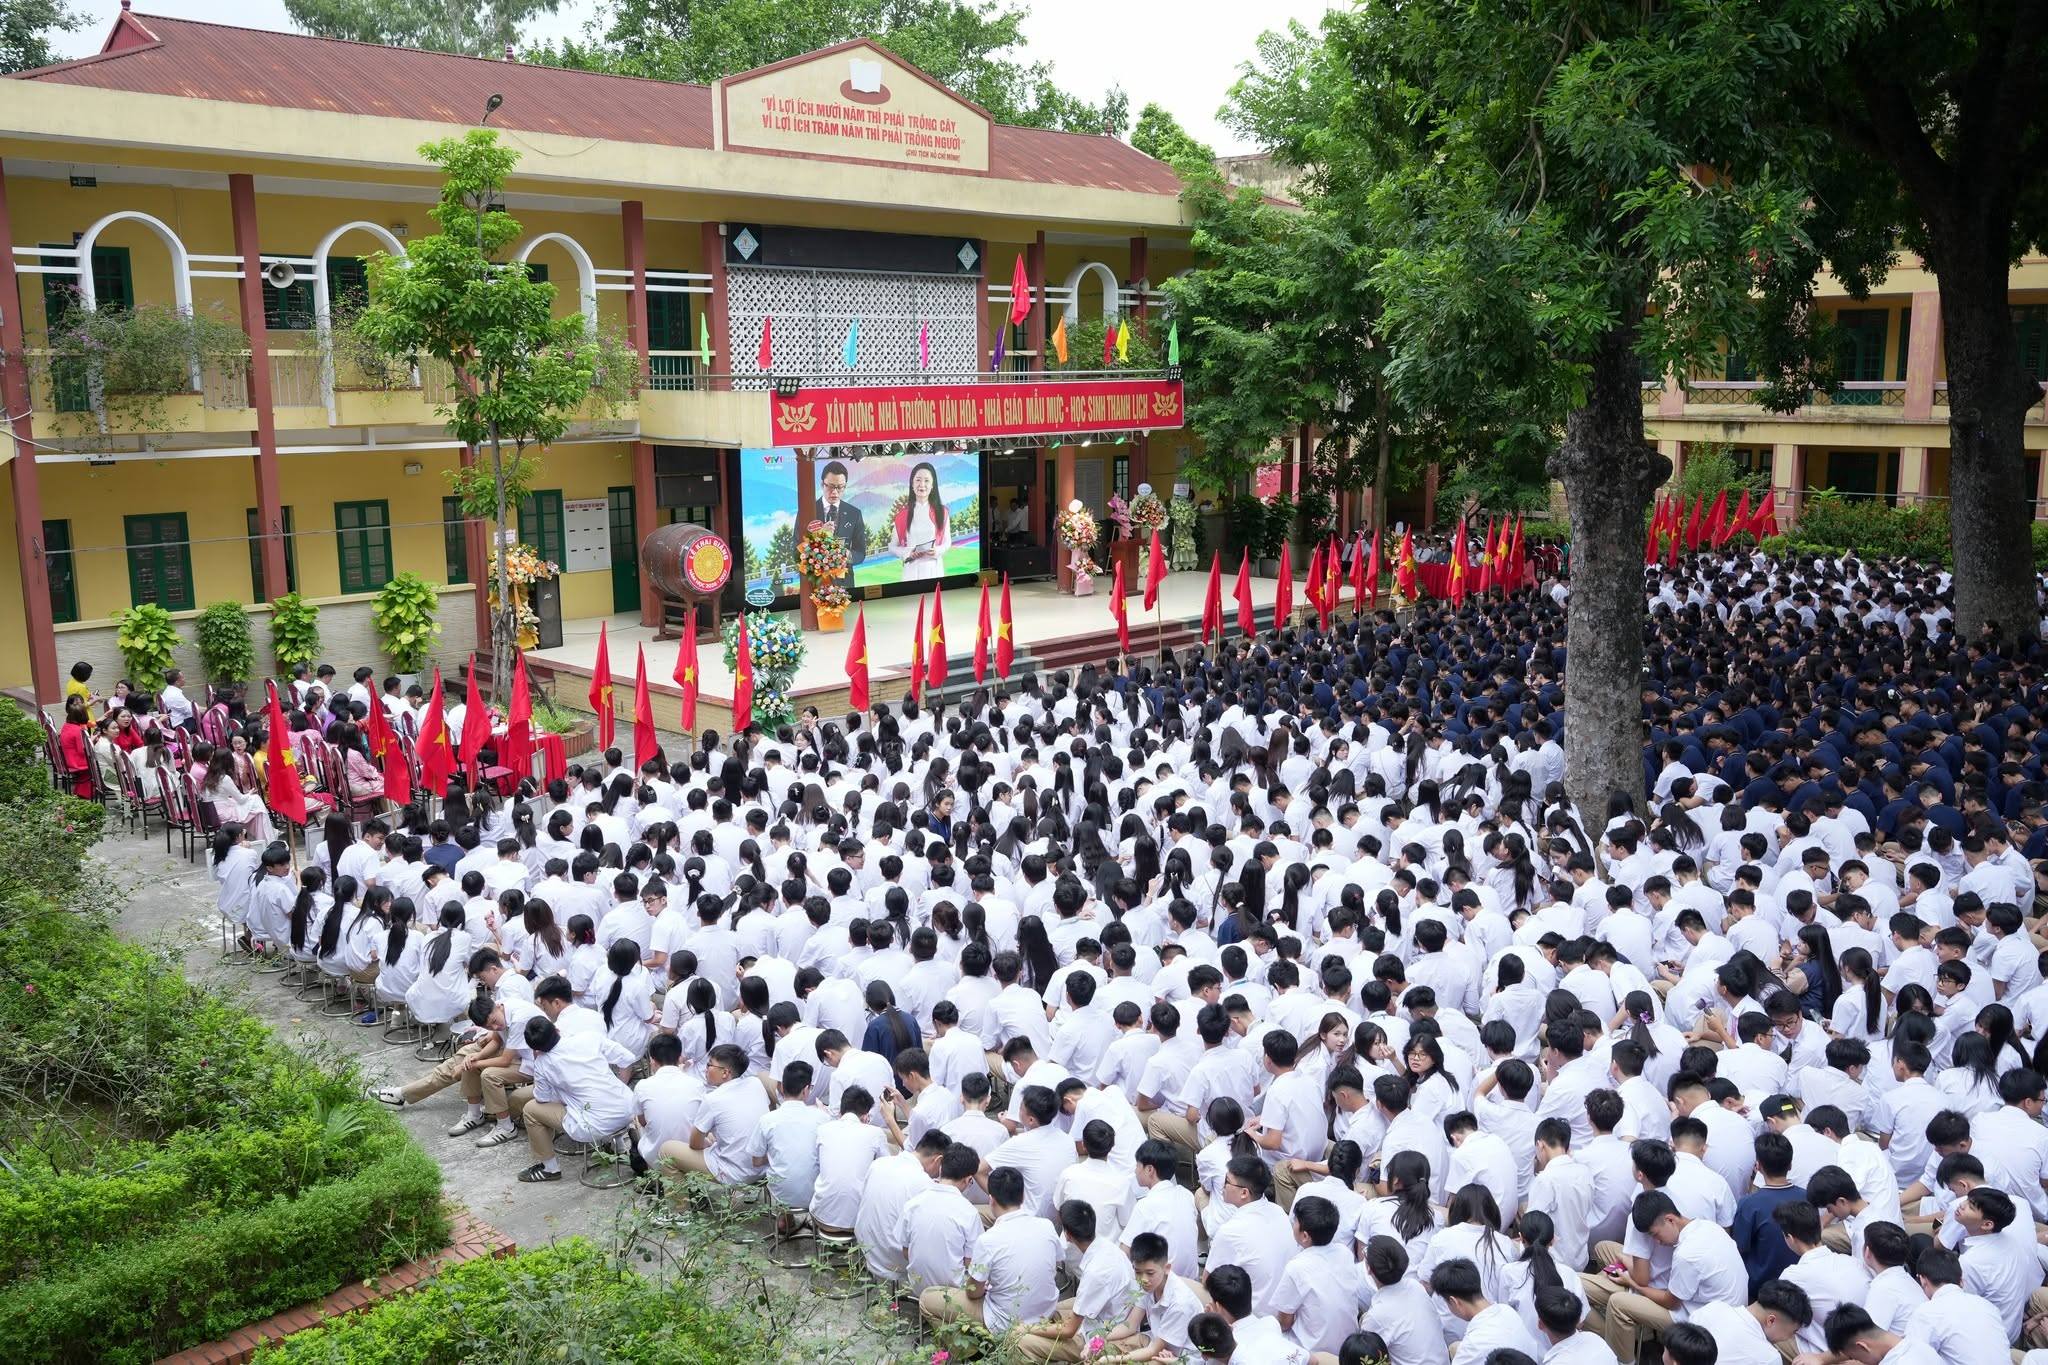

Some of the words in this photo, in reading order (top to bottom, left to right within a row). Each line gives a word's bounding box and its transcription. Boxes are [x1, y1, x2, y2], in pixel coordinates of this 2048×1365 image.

[762, 112, 772, 129] VÌ
[775, 115, 791, 132] LỢI
[793, 114, 810, 133] ÍCH
[811, 119, 839, 136] TRĂM
[841, 122, 863, 139] NĂM
[865, 125, 880, 141] THÌ
[882, 127, 902, 144] PHẢI
[904, 129, 933, 147] TRỒNG
[779, 98, 794, 115] LỢI
[797, 97, 813, 116] ÍCH
[816, 101, 841, 119] MƯỜI
[843, 105, 865, 122] NĂM
[866, 107, 881, 124] THÌ
[883, 109, 904, 127] PHẢI
[908, 114, 937, 131] TRỒNG
[940, 118, 956, 134] CÂY
[826, 397, 845, 434] XÂY
[847, 399, 875, 438] DỰNG
[878, 395, 899, 431] NHÀ
[900, 391, 936, 430] TRƯỜNG
[940, 393, 958, 429] VĂN
[960, 392, 978, 428] HÓA
[984, 392, 1002, 427] NHÀ
[1004, 391, 1023, 426] GIÁO
[1026, 387, 1044, 425] MẪU
[1047, 393, 1064, 429] MỰC
[1070, 395, 1086, 428] HỌC
[1087, 395, 1106, 422] SINH
[1106, 394, 1131, 421] THANH
[1132, 394, 1148, 425] LỊCH
[763, 455, 783, 464] VTV1
[695, 539, 712, 550] KHAI
